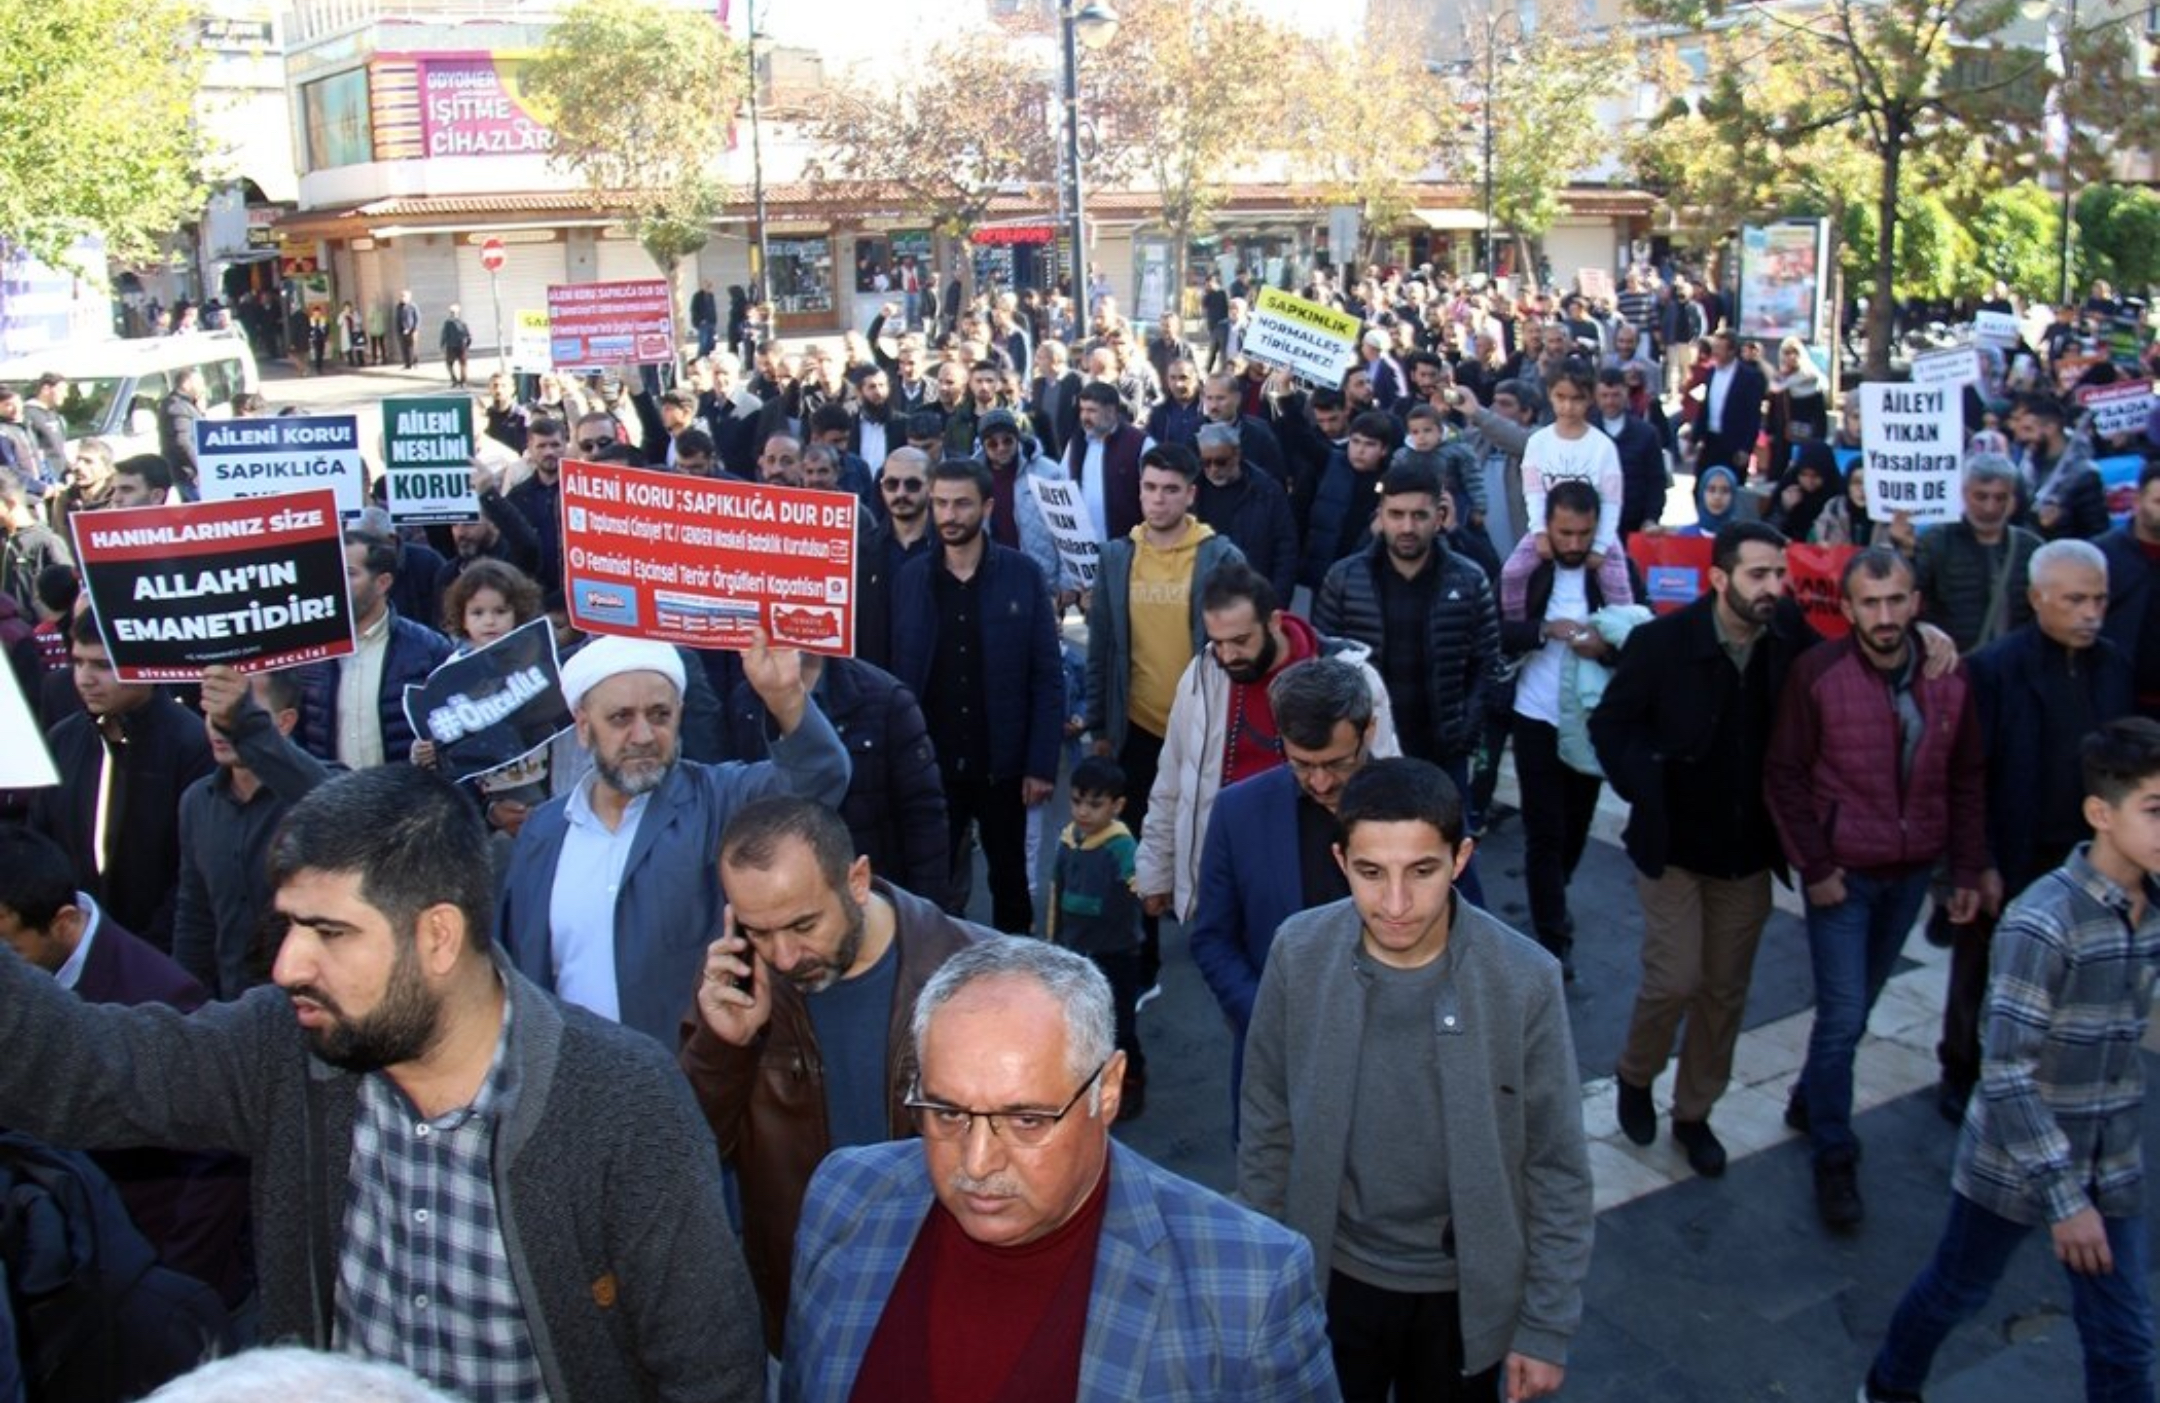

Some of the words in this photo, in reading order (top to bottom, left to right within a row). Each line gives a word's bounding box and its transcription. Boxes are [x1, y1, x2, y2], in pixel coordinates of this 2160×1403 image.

[428, 92, 511, 127] İŞİTME
[1267, 296, 1350, 334] SAPKINLIK
[1261, 333, 1334, 368] TİRİLEMEZ!
[1882, 388, 1943, 413] AİLEYİ
[397, 408, 460, 435] AİLENİ
[1883, 423, 1939, 442] YIKAN
[205, 425, 278, 447] AİLENİ
[283, 426, 351, 445] KORU!
[392, 436, 468, 462] NESLİNİ
[216, 455, 346, 480] SAPIKLIĞA
[1869, 451, 1957, 471] Yasalara
[393, 473, 472, 501] KORU!
[565, 469, 621, 501] AİLENİ
[625, 481, 674, 509] KORU
[779, 501, 817, 526] DUR
[822, 505, 852, 529] DE!
[1878, 480, 1917, 501] DUR
[1923, 480, 1946, 500] DE
[91, 517, 265, 549] HANIMLARINIZ
[270, 508, 324, 533] SİZE
[586, 551, 633, 576] Feminist
[634, 558, 678, 584] Eşcinsel
[679, 564, 711, 588] Terör
[712, 564, 766, 596] Örgütleri
[113, 594, 336, 642] EMANETİDİR!
[264, 646, 328, 667] MECLİSİ
